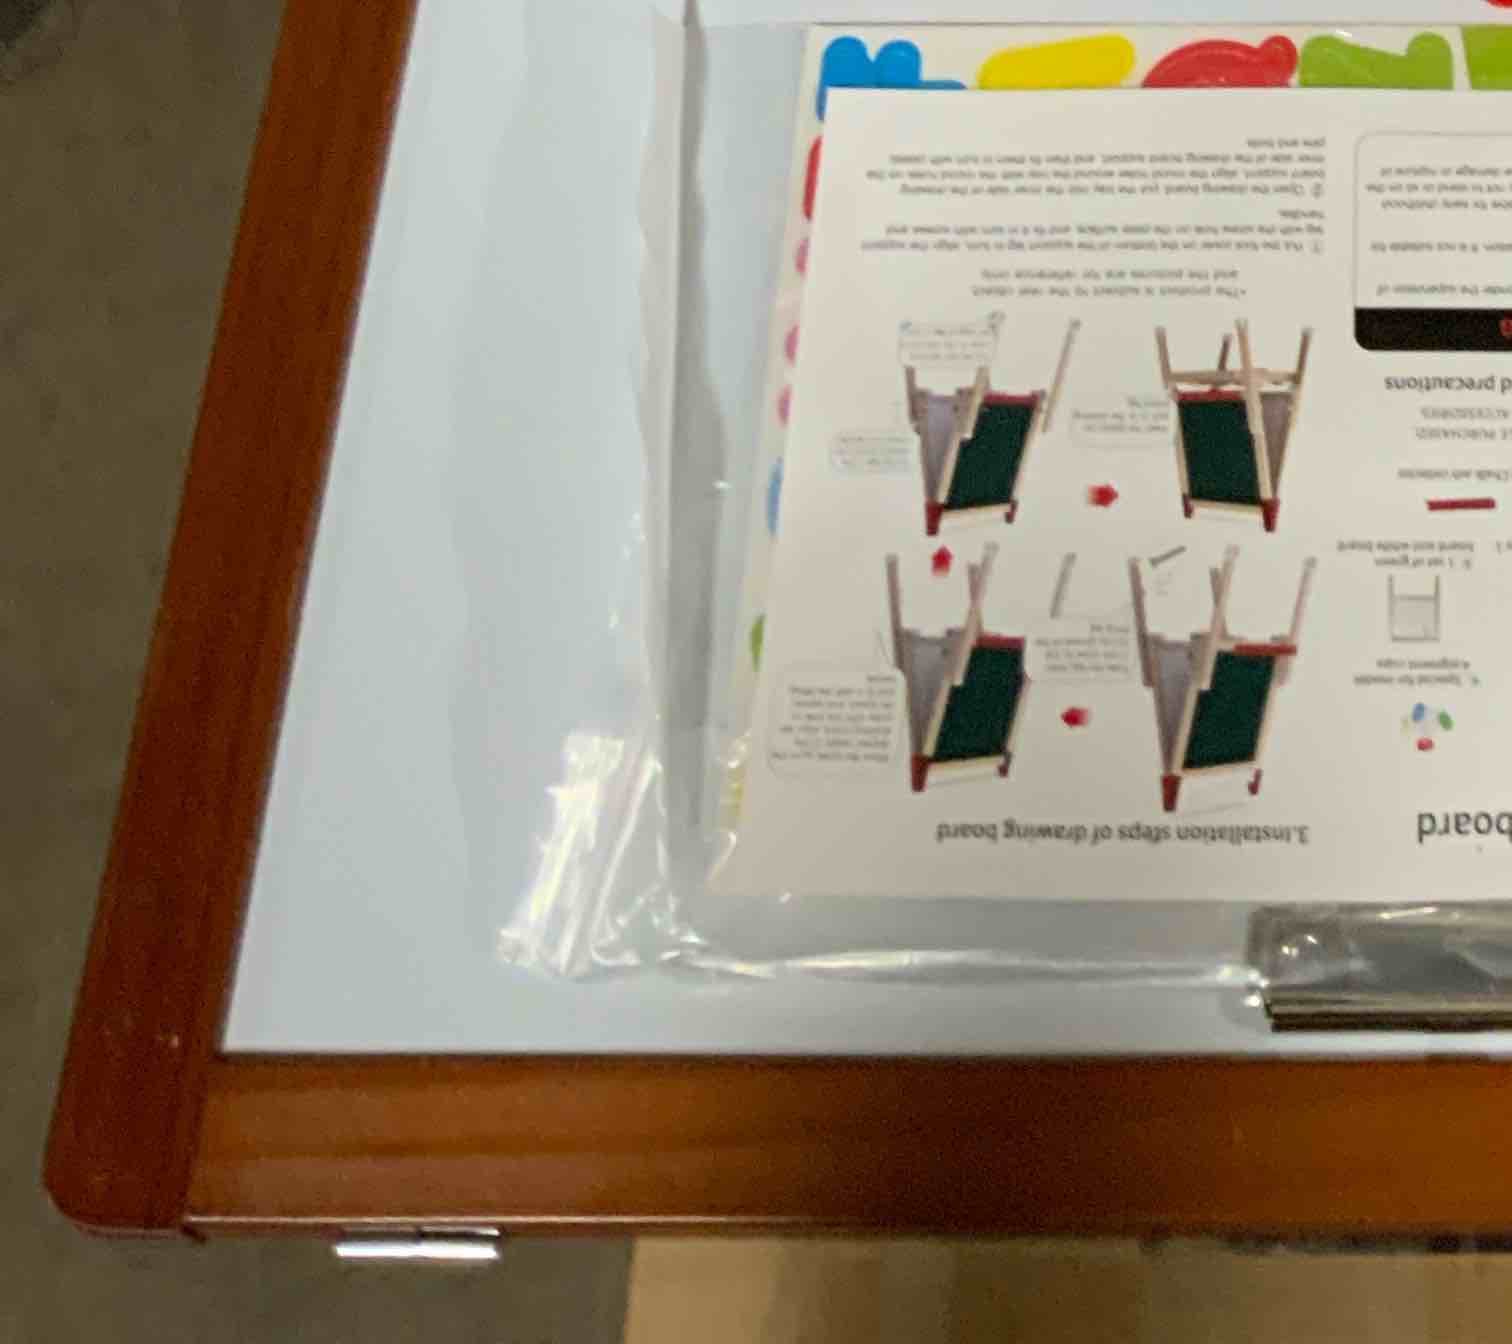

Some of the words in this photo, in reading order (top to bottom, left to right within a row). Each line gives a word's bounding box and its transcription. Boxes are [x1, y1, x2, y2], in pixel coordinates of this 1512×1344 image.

[1383, 373, 1496, 393] precautions
[935, 823, 998, 844] board
[1002, 818, 1088, 845] drawing
[1091, 823, 1114, 845] of
[1118, 821, 1172, 844] steps
